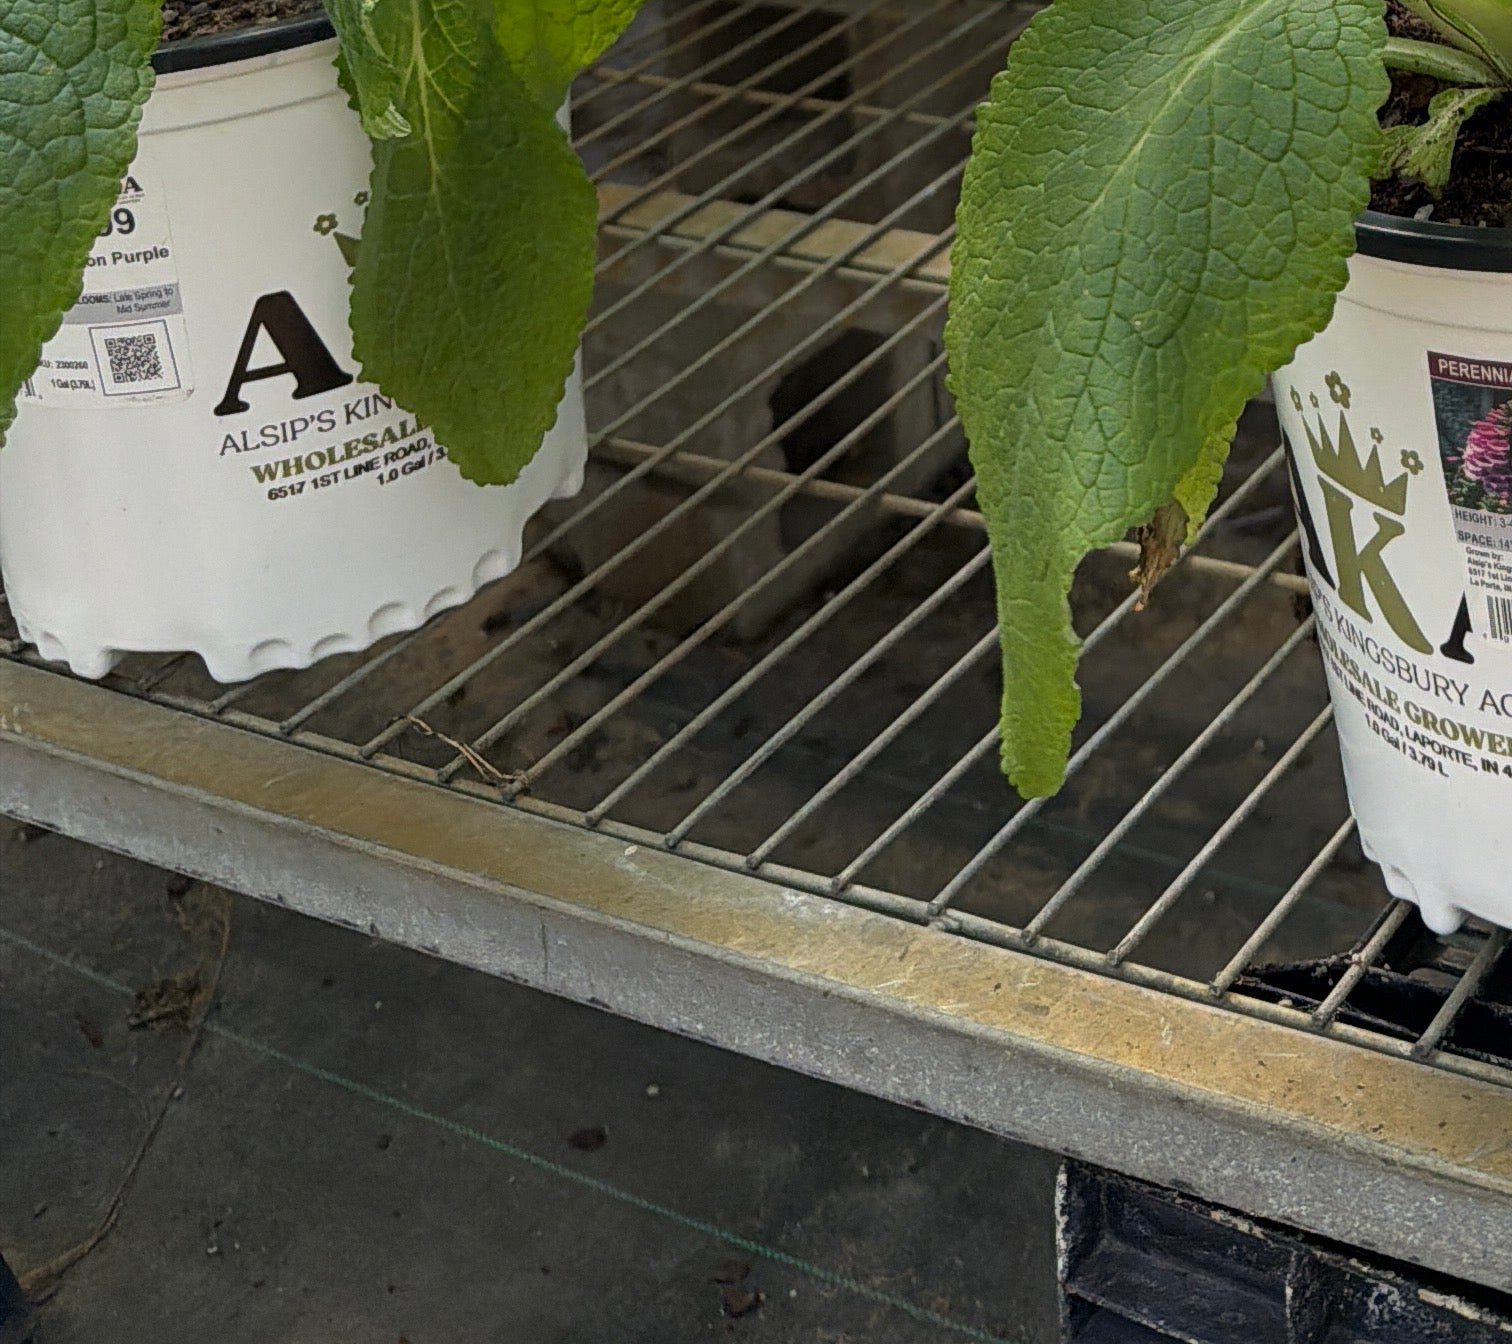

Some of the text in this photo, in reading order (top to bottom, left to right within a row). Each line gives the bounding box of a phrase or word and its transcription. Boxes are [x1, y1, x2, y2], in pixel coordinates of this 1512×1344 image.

[112, 246, 170, 266] Purple
[219, 409, 337, 456] ALSIP'S
[250, 419, 430, 484] WHOLESAL
[267, 437, 433, 501] 6517 1ST LINE ROAD,
[376, 465, 399, 486] 1.0
[401, 453, 426, 477] Gal
[1454, 509, 1496, 527] HEIGHT:
[1457, 530, 1496, 548] SPACE:
[1465, 546, 1504, 562] Grown by:
[1469, 577, 1479, 586] La
[1503, 583, 1512, 593] IN
[1487, 570, 1500, 581] 1st
[1334, 607, 1470, 706] KINGSBURY
[1367, 696, 1404, 736] ROAD,
[1405, 725, 1478, 771] LAPORTE,
[1480, 757, 1499, 775] IN
[1438, 760, 1449, 778] L
